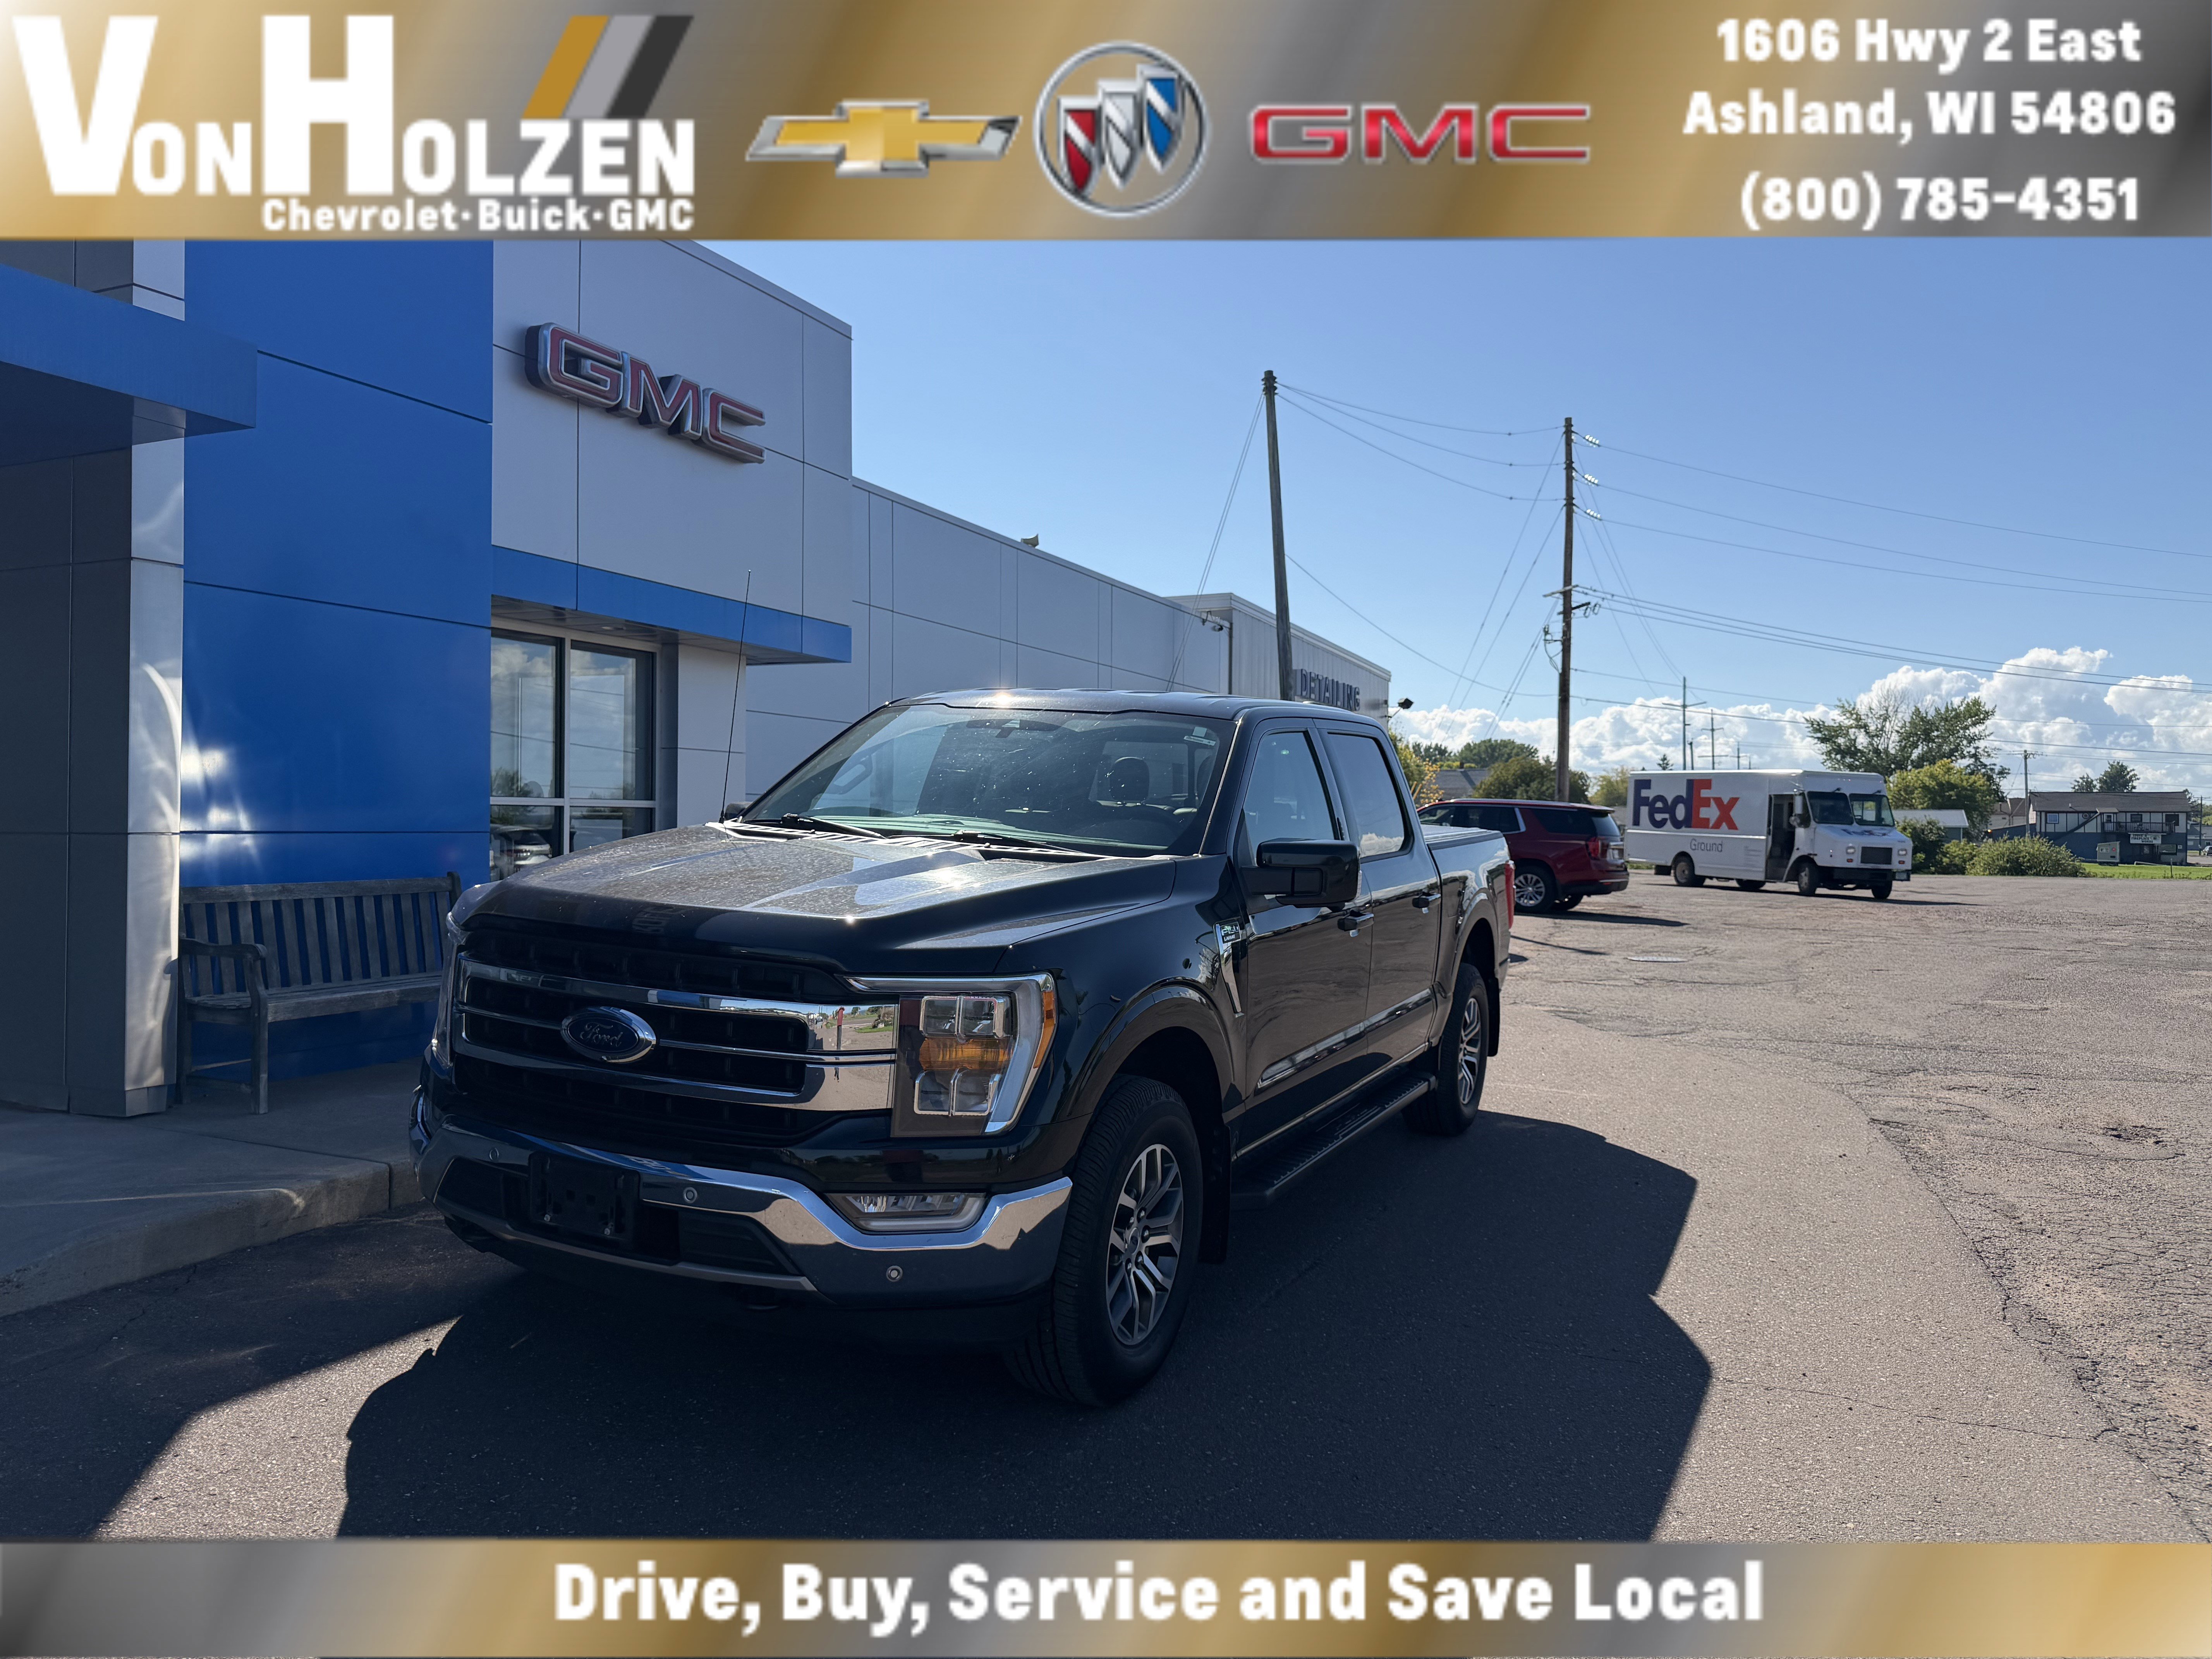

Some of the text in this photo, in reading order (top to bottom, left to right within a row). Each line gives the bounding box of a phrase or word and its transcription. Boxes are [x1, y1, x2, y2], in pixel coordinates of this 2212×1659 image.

[526, 322, 766, 464] GMC
[1299, 668, 1361, 712] DETAILING
[1632, 778, 1740, 830] FedEx
[1690, 838, 1723, 852] Ground
[580, 1021, 623, 1048] Ford
